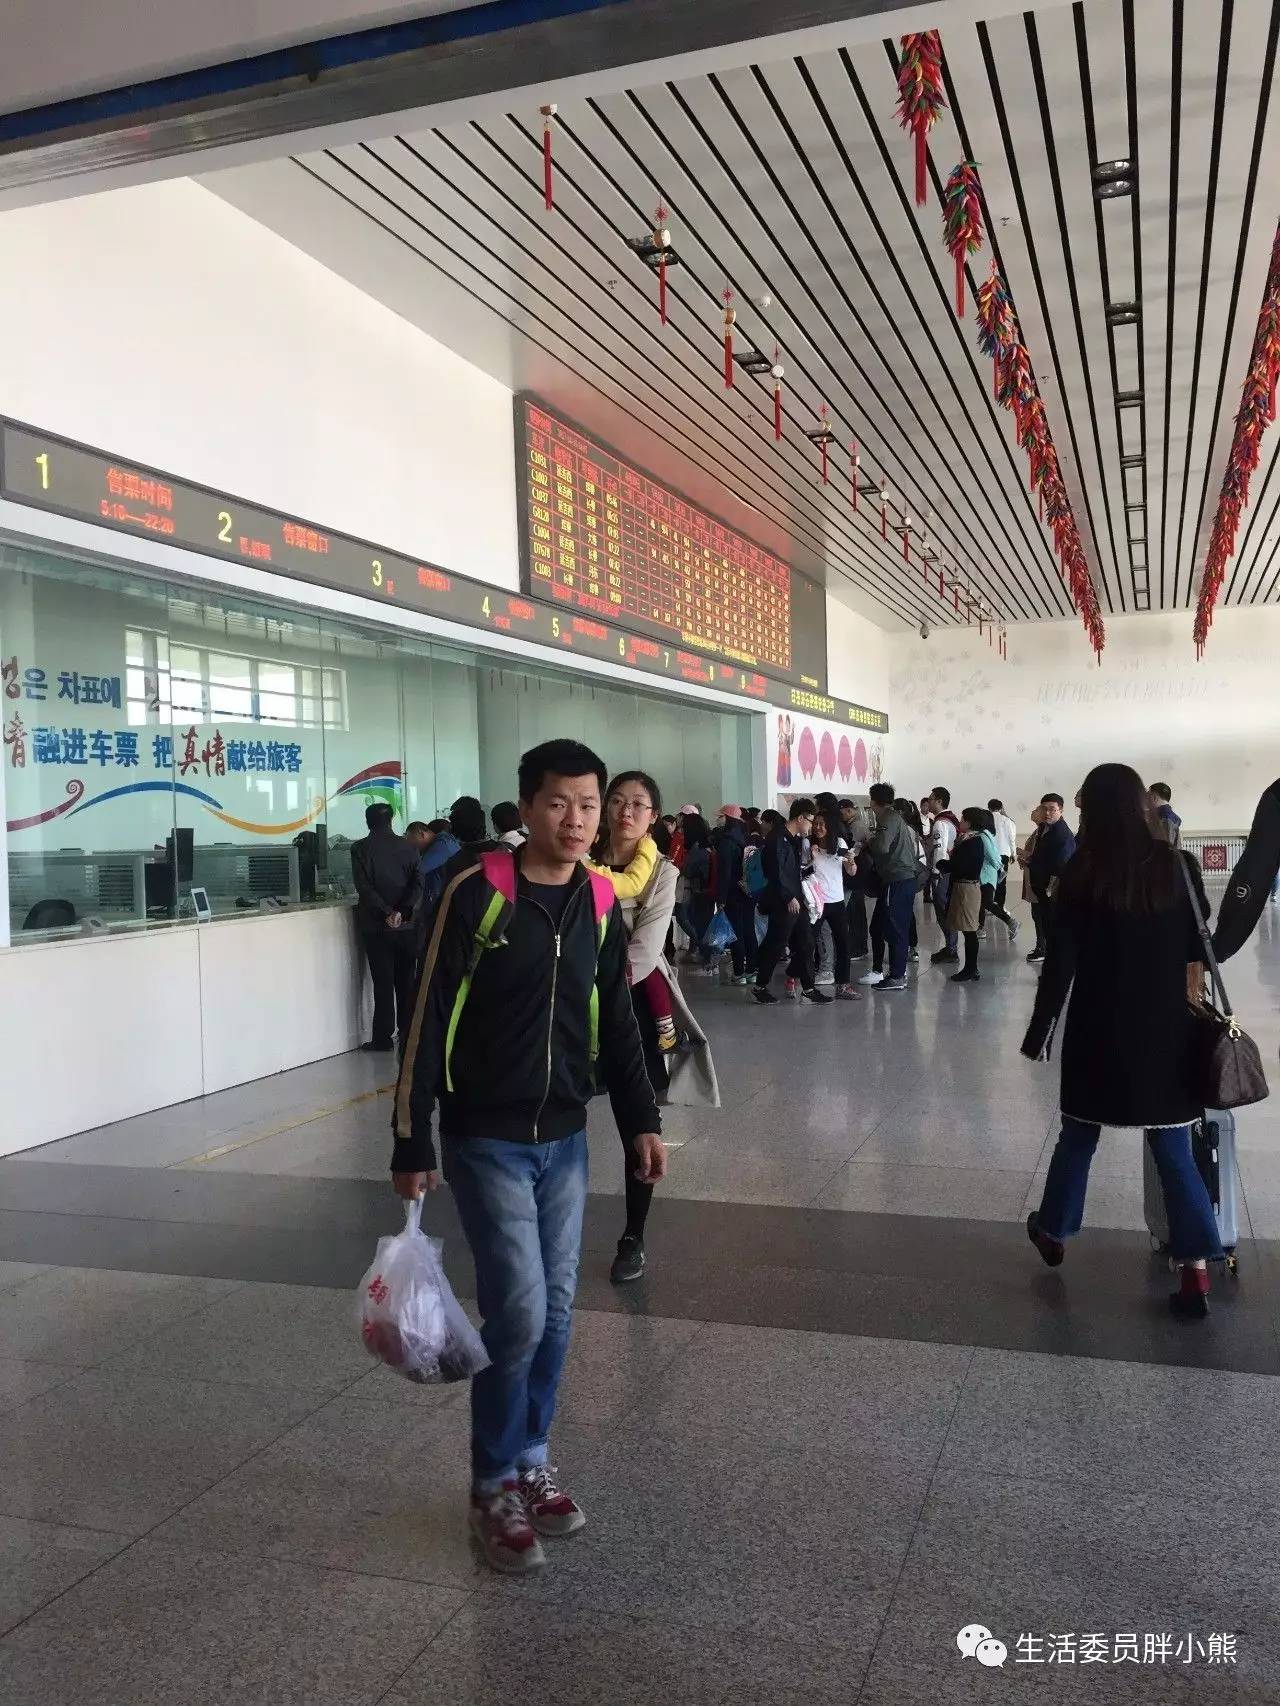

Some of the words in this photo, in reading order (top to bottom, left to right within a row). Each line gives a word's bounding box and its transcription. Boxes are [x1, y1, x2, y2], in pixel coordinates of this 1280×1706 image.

[35, 453, 49, 490] 1
[217, 511, 232, 543] 2
[371, 559, 383, 587] 3
[481, 596, 491, 618] 4
[551, 617, 560, 638] 5
[618, 637, 625, 656] 6
[663, 651, 670, 668] 7
[58, 671, 121, 708] 차표에
[152, 725, 303, 777] 把真情献给旅客
